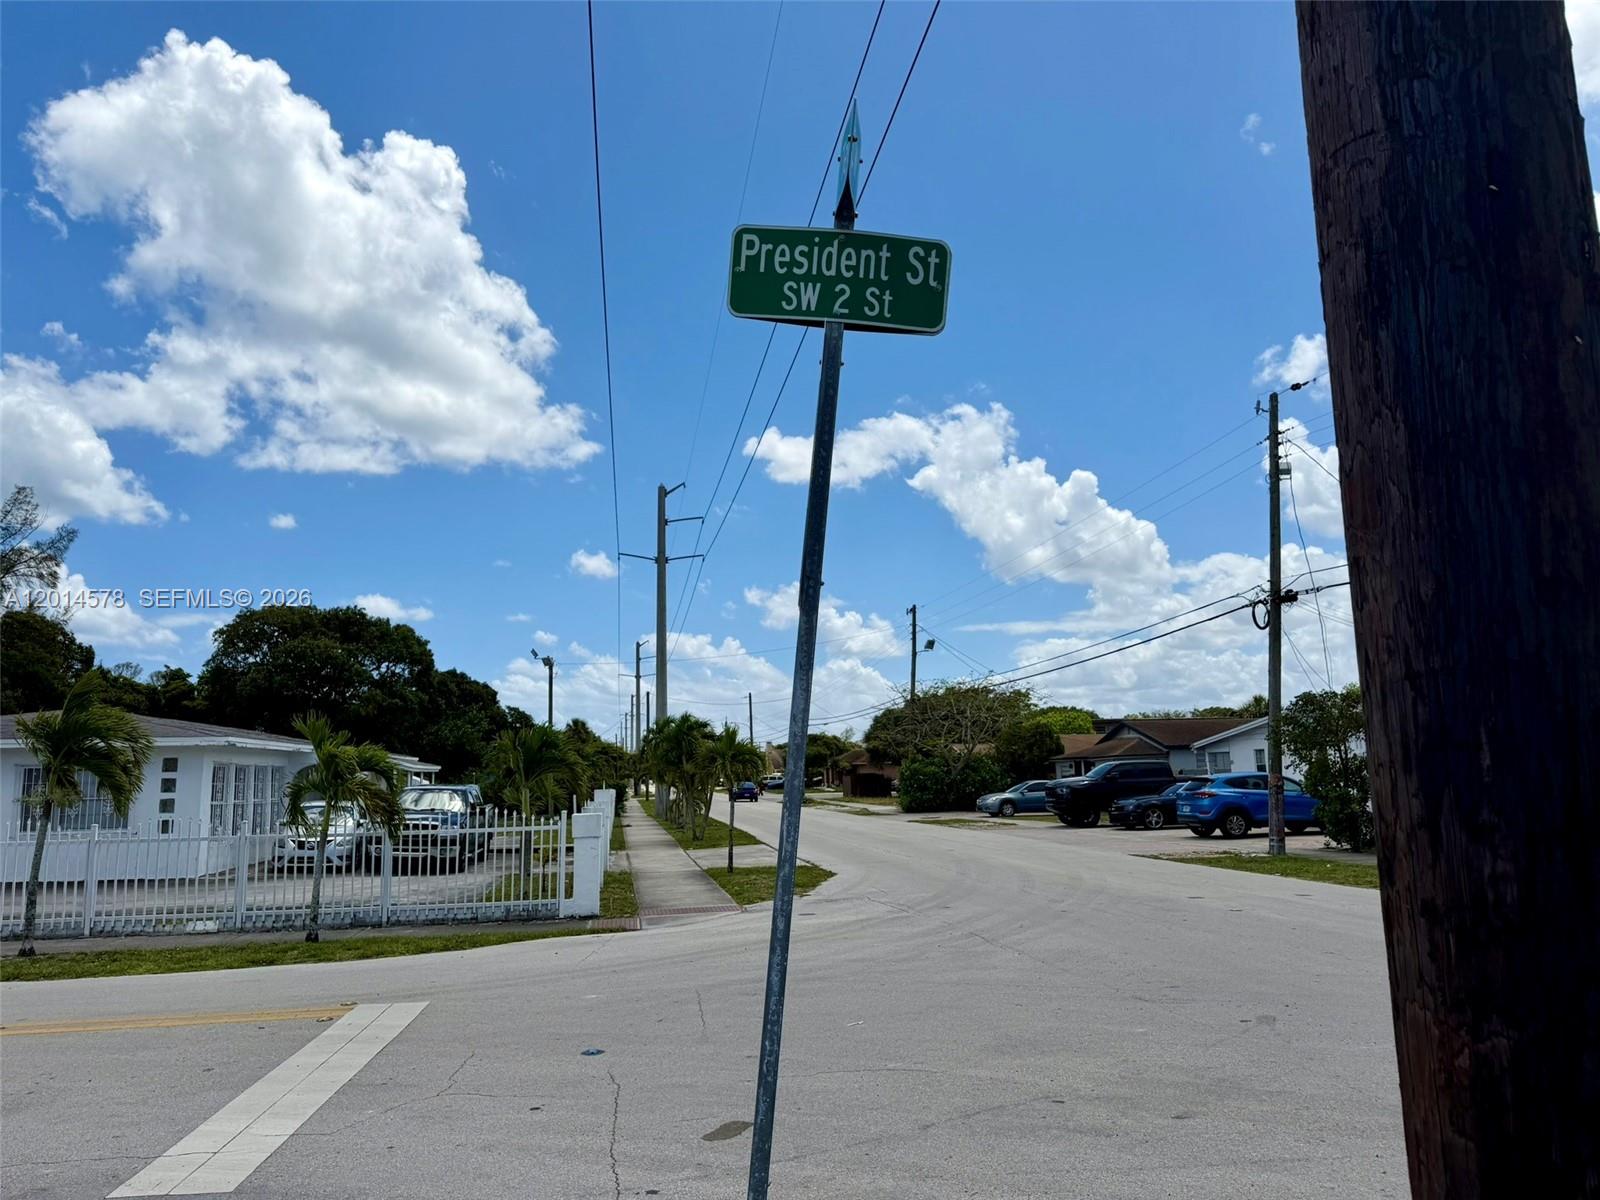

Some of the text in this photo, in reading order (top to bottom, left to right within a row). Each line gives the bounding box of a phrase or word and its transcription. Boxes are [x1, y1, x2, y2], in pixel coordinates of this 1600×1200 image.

[740, 233, 940, 287] President St
[781, 281, 893, 318] SW 2 St
